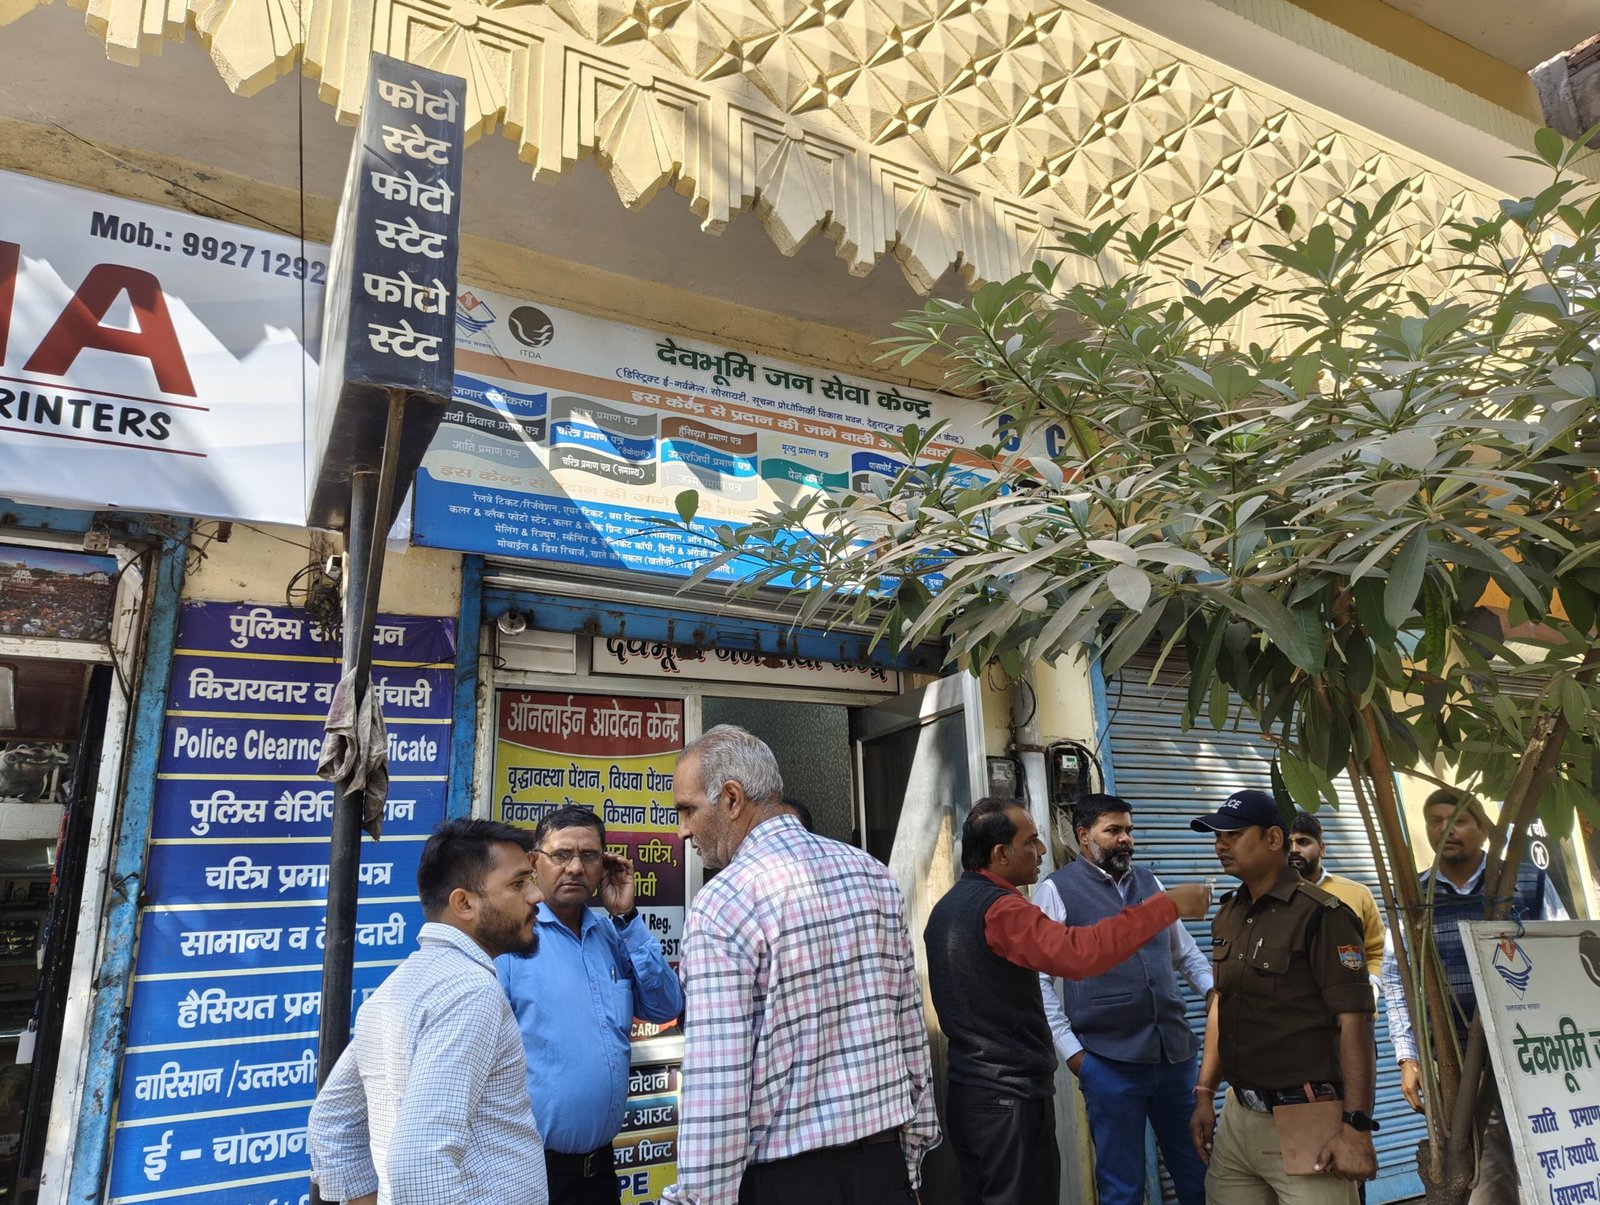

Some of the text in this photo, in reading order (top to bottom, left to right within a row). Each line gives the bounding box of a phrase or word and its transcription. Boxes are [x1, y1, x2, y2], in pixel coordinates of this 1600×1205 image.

[377, 79, 459, 123] फोटो
[382, 124, 452, 165] स्टेट
[370, 170, 455, 215] फोटो
[90, 211, 329, 285] Mob.: 99271292
[375, 216, 447, 260] स्टेट
[363, 270, 450, 316] फोटो
[368, 319, 443, 362] स्टेट
[520, 349, 542, 360] ITDA
[656, 338, 932, 420] देवभूमि जन सेवा केन्द्र
[467, 413, 496, 428] निवास
[525, 425, 539, 436] पत्र
[624, 416, 638, 426] पत्र
[631, 390, 661, 405] इस
[709, 404, 726, 418] से
[730, 411, 773, 426] प्रदान
[777, 416, 800, 432] की
[804, 424, 838, 440] जाने
[841, 432, 875, 446] वाली
[818, 408, 843, 421] विकास
[453, 439, 476, 452] जाति
[708, 432, 728, 443] प्रमाण
[731, 436, 742, 446] पत्र
[798, 447, 815, 458] प्रमाण
[816, 449, 829, 459] पत्र
[472, 491, 493, 503] रेलवे
[448, 504, 471, 515] कलर
[474, 508, 481, 517] &
[507, 512, 528, 522] फोटो
[575, 521, 582, 529] &
[521, 527, 528, 536] &
[591, 536, 598, 545] &
[678, 547, 684, 556] &
[531, 543, 538, 552] &
[229, 608, 301, 648] पुलिस
[189, 668, 335, 704] किरायदार व
[507, 694, 680, 743] ऑनलाईन आवेदन केन्द्र
[174, 727, 237, 759] Police
[244, 729, 323, 761] Clearnc
[508, 763, 674, 794] वृद्धावस्था पेंशन, विधवा पेंशन
[190, 790, 268, 836] पुलिस
[603, 798, 646, 825] किसान
[650, 801, 679, 825] पेंशन
[638, 838, 678, 867] चरित्र,
[205, 856, 271, 890] चरित्र
[278, 864, 330, 892] प्रमा
[649, 913, 671, 934] Reg.
[180, 926, 310, 957] सामान्य व
[177, 988, 277, 1028] हैसियत
[631, 1022, 660, 1038] CARD
[1513, 1016, 1592, 1093] देवभूमि
[135, 1049, 318, 1101] वारिसान /उत्तरजी
[634, 1105, 673, 1126] आउट
[1528, 1106, 1559, 1134] जाति
[143, 1130, 174, 1181] ई
[180, 1149, 202, 1161] -
[638, 1138, 673, 1162] प्रिन्ट
